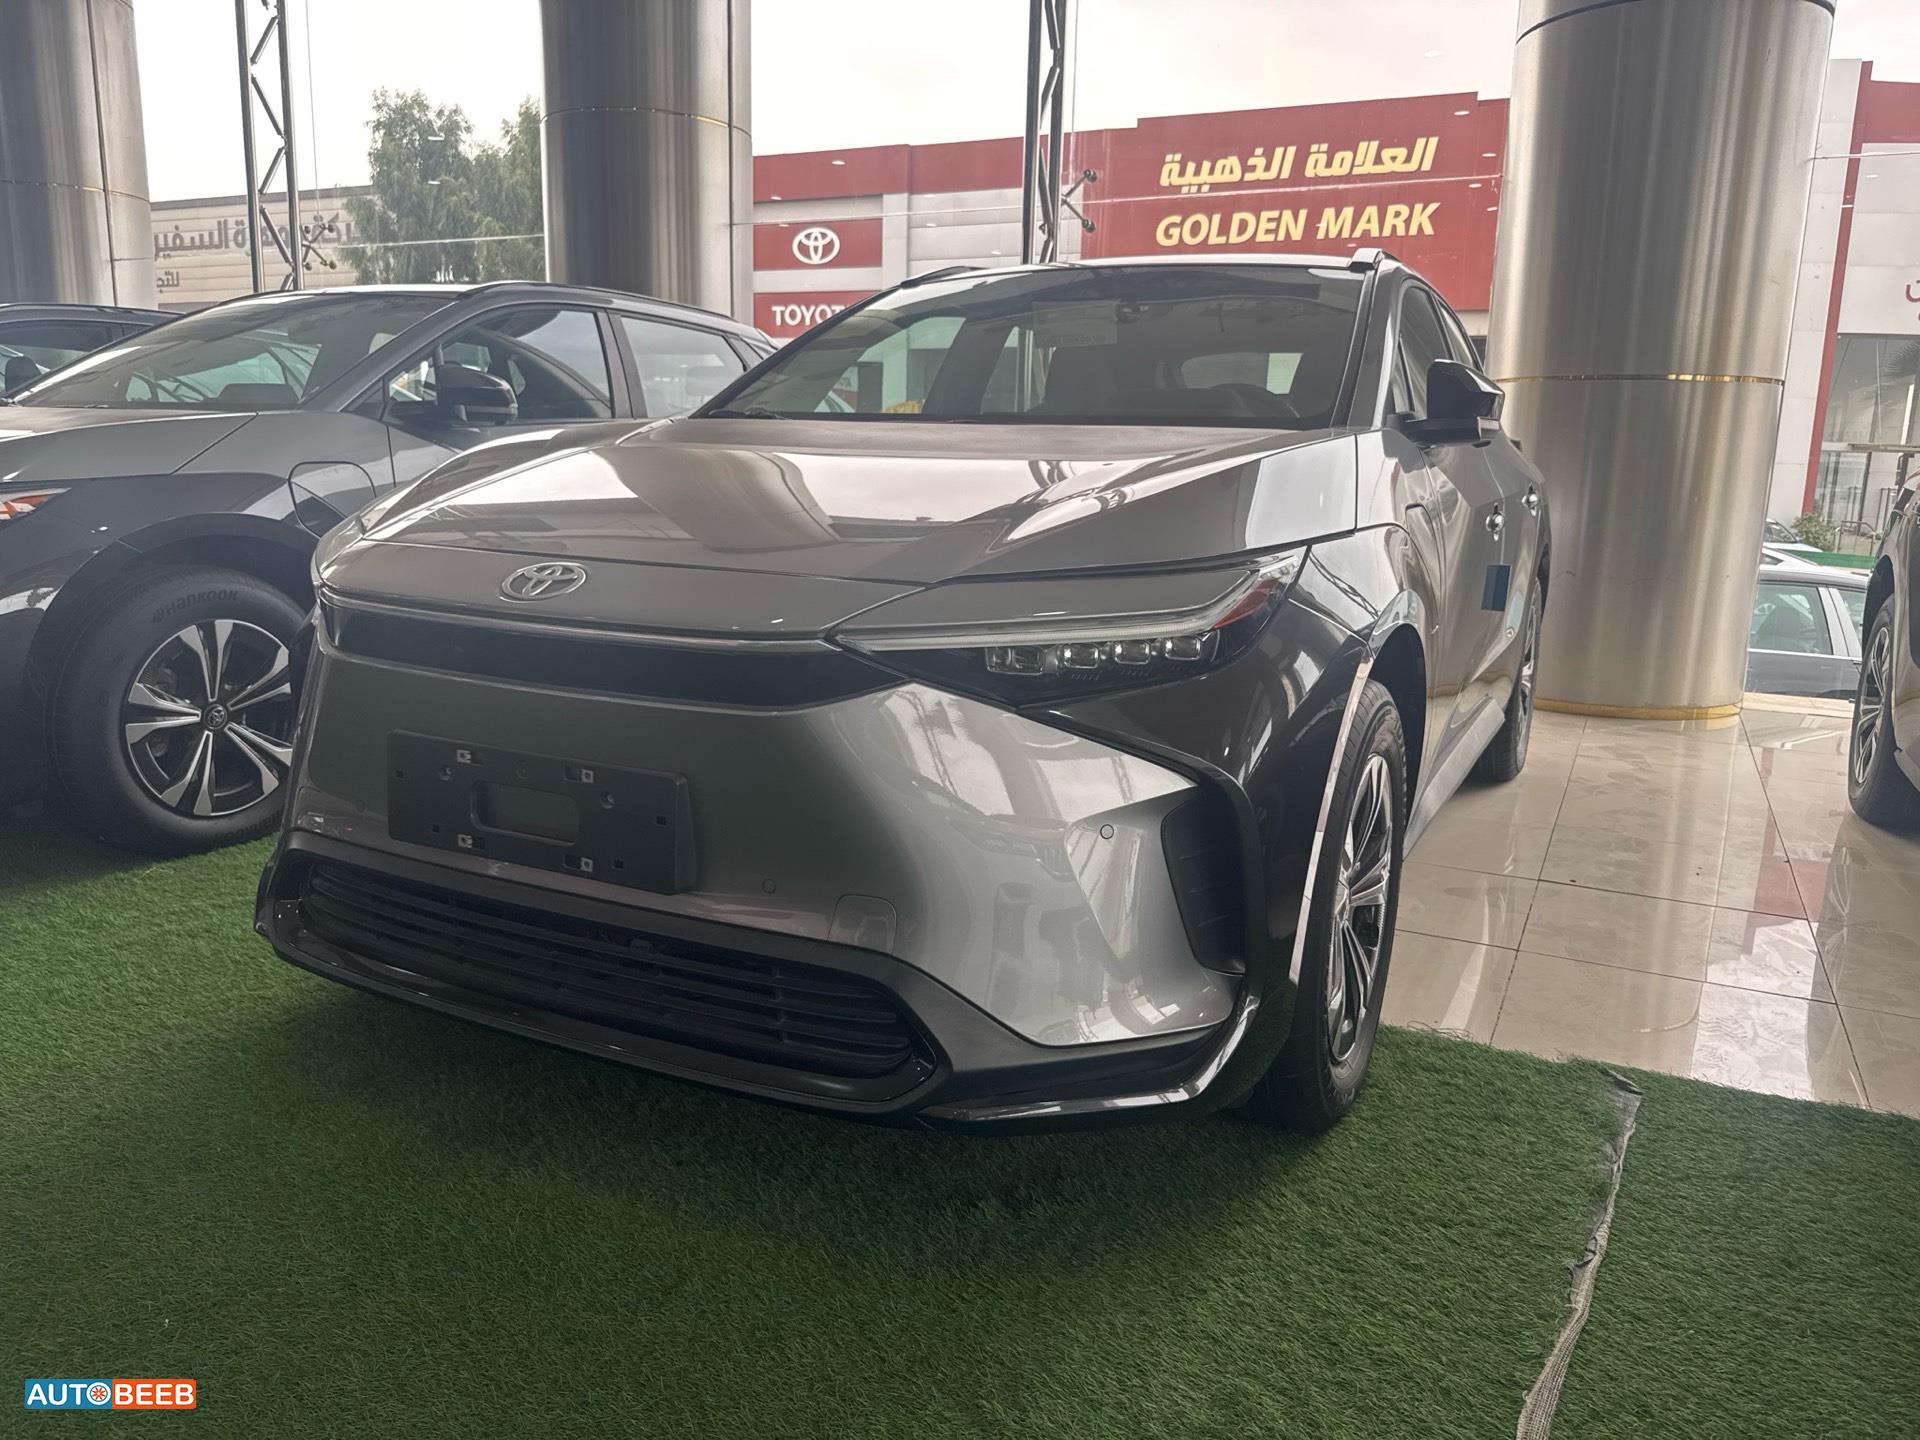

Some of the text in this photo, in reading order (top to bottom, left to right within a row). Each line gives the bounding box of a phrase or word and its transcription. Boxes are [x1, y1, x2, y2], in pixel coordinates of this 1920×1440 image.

[1159, 136, 1439, 194] العلامة الذهبية
[1155, 202, 1441, 247] GOLDEN MARK
